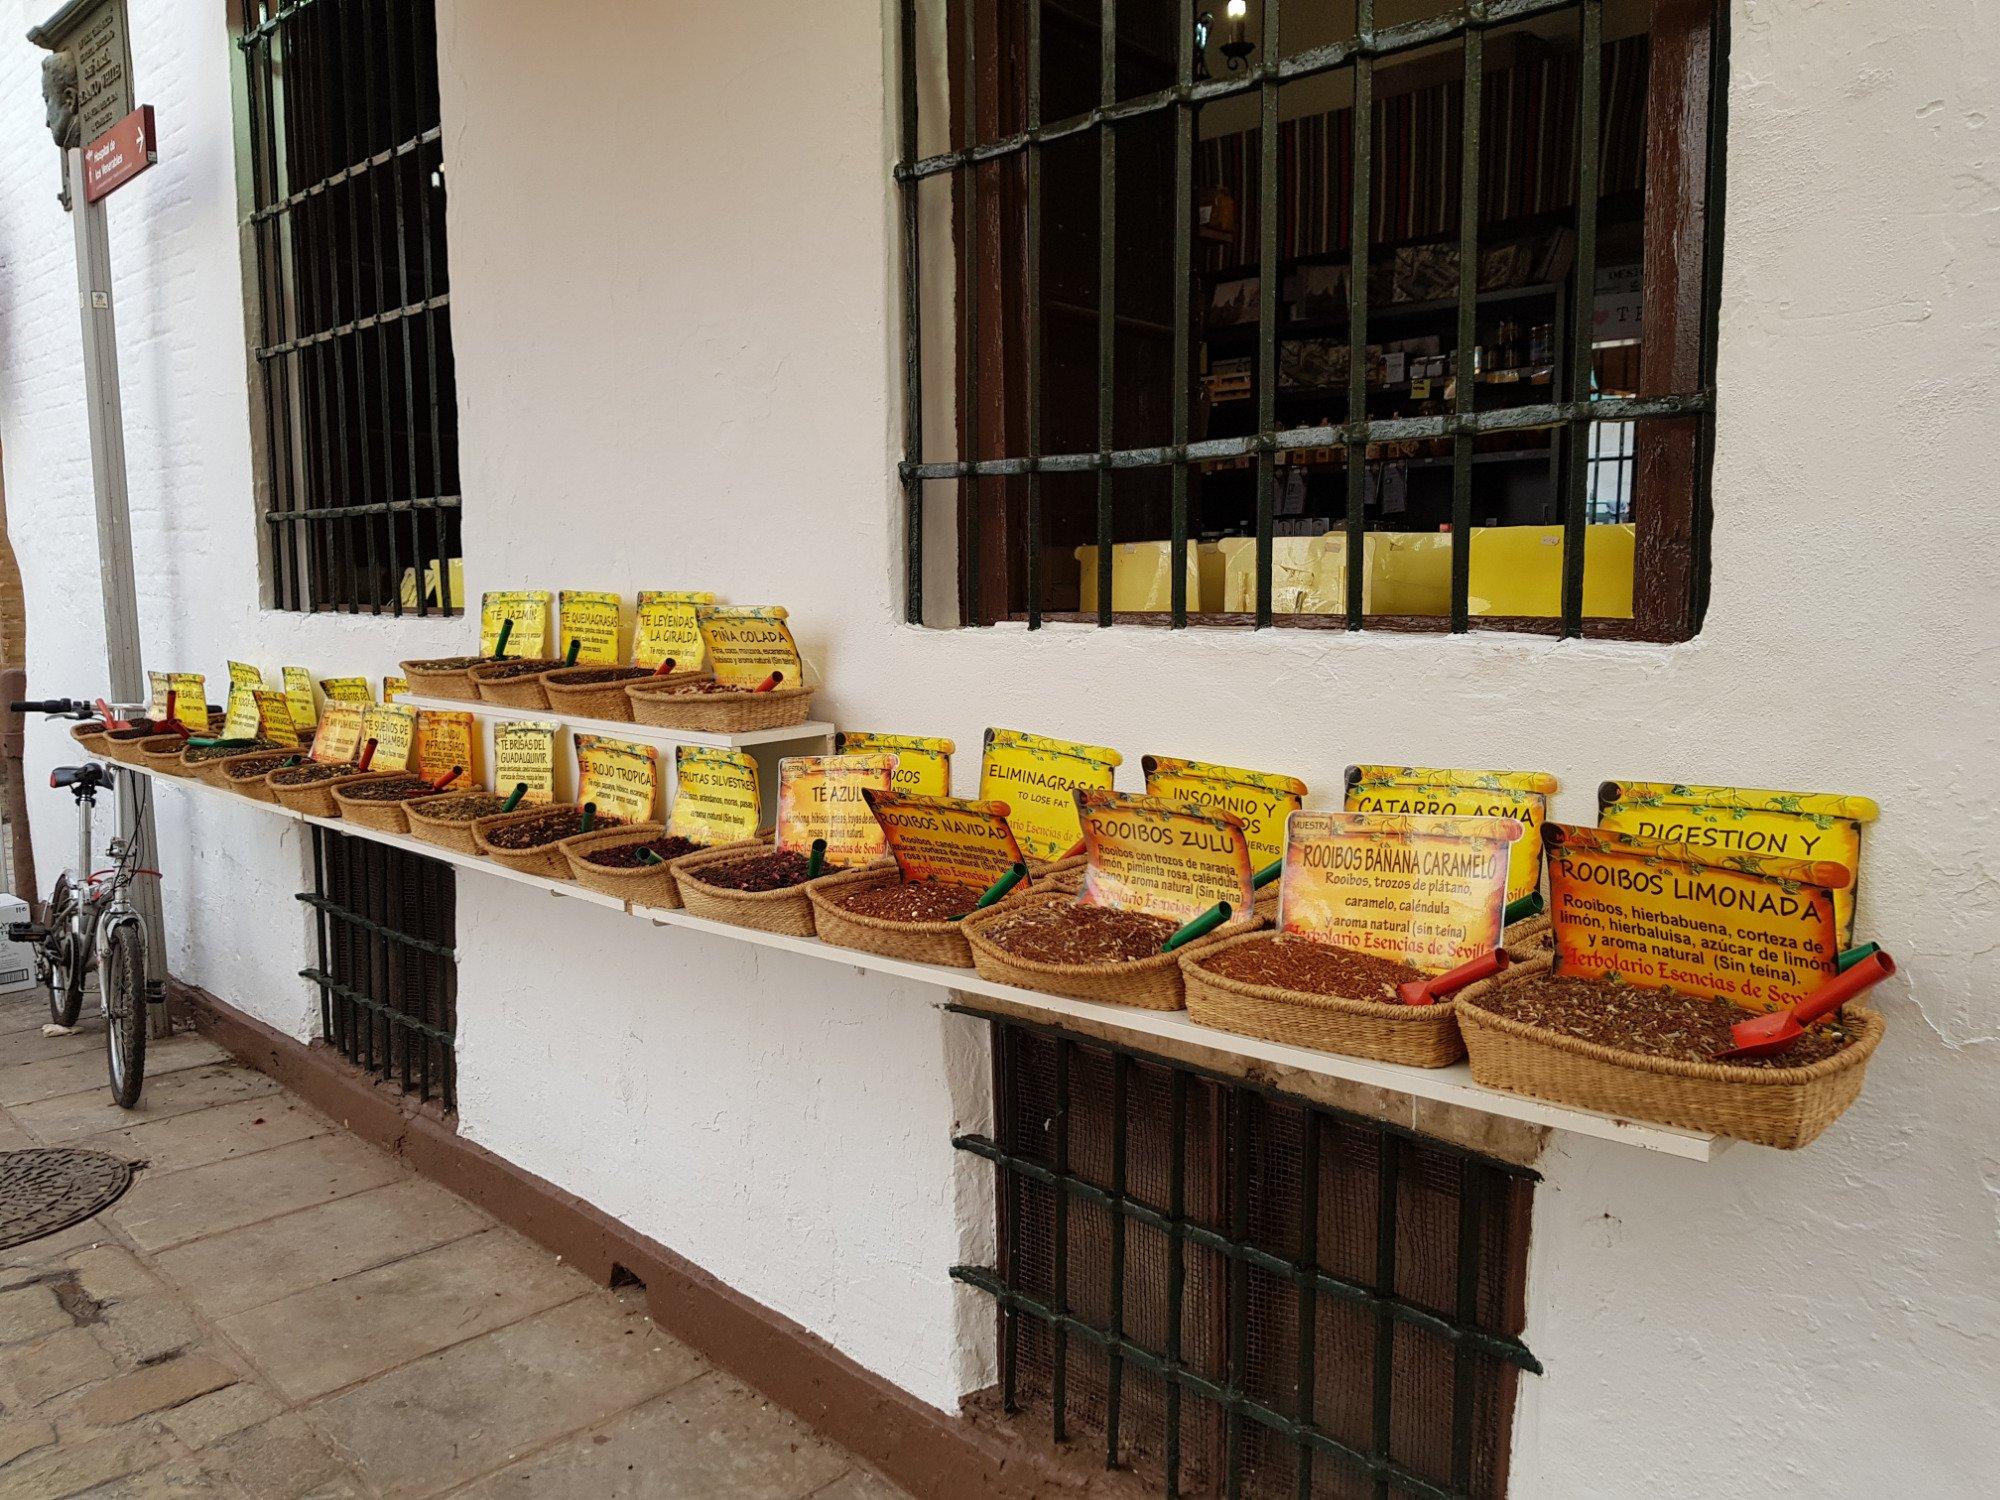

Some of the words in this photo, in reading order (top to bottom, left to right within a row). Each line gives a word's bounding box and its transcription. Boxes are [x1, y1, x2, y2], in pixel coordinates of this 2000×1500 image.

[654, 614, 694, 628] LEYENDAS
[650, 630, 661, 641] LA
[664, 630, 697, 643] GIRALDA
[711, 627, 739, 642] PIÑA
[740, 631, 788, 643] COLADA
[399, 722, 409, 735] DE
[510, 739, 533, 750] BRISAS
[534, 739, 546, 750] DEL
[500, 752, 548, 764] GUADALQUIVIR
[592, 762, 615, 777] ROJO
[616, 767, 657, 788] TROPICAL
[680, 770, 710, 785] FRUTAS
[711, 774, 756, 792] SILVESTRES
[812, 782, 827, 802] TÉ
[830, 786, 862, 802] AZUL
[1018, 791, 1029, 800] TO
[1031, 793, 1051, 805] LOSE
[1053, 798, 1070, 808] FAT
[1174, 787, 1257, 815] INSOMNIO
[1263, 802, 1276, 819] Y
[1358, 797, 1457, 815] CATARRO
[1474, 805, 1535, 827] ASMA
[808, 829, 824, 837] rosas
[878, 812, 939, 831] ROOIBOS
[942, 819, 1008, 840] NAVIDAD
[1026, 821, 1062, 839] Esencias
[1063, 829, 1073, 842] de
[1091, 819, 1173, 845] ROOIBOS
[1180, 830, 1234, 854] ZULU
[1292, 820, 1330, 831] MUESTRA
[1638, 822, 1788, 853] DIGESTION
[1800, 834, 1821, 856] Y
[904, 852, 921, 860] rosa
[929, 855, 953, 864] aroma
[953, 858, 981, 868] natural
[1098, 844, 1134, 859] Rooibos
[1136, 852, 1153, 862] con
[1154, 853, 1184, 867] trozos
[1186, 858, 1198, 869] de
[1200, 861, 1239, 878] naranja,
[1303, 844, 1362, 871] ROOIBOS
[1364, 848, 1421, 875] BANANA
[1423, 850, 1497, 880] CARAMELO
[1123, 874, 1130, 886] y
[1131, 876, 1159, 889] aroma
[1161, 880, 1193, 894] natural
[1196, 884, 1214, 899] (Sin
[1127, 861, 1165, 877] pimienta
[1167, 868, 1190, 883] rosa,
[1192, 873, 1242, 891] caléndula,
[1325, 871, 1372, 888] Rooibos,
[1374, 876, 1411, 890] trozos
[1412, 878, 1427, 891] de
[1428, 879, 1473, 897] plátano,
[1560, 859, 1664, 895] ROOIBOS
[1674, 877, 1822, 924] LIMONADA
[1345, 896, 1397, 912] caramelo,
[1399, 897, 1450, 915] caléndula
[1325, 916, 1333, 928] y
[1333, 917, 1368, 929] aroma
[1370, 918, 1410, 932] natural
[1412, 920, 1433, 937] (sin
[1436, 923, 1467, 942] teína)
[1563, 893, 1627, 919] Rooibos,
[1631, 905, 1732, 938] hierbabuena,
[1737, 927, 1797, 949] corteza
[1802, 938, 1823, 954] de
[1364, 931, 1424, 953] Esencias
[1427, 938, 1444, 955] de
[1447, 940, 1486, 959] Sevill
[1560, 910, 1605, 931] limón,
[1609, 917, 1696, 948] hierbaluisa,
[1701, 938, 1753, 957] azúcar
[1758, 947, 1779, 962] de
[1784, 951, 1832, 973] limón
[1563, 944, 1654, 976] Herbolario
[1657, 962, 1736, 993] Esencias
[1740, 979, 1763, 998] de
[1588, 933, 1596, 947] y
[1601, 935, 1647, 954] aroma
[1652, 945, 1704, 965] natural
[1714, 954, 1745, 973] (Sin
[1750, 961, 1801, 986] teína).
